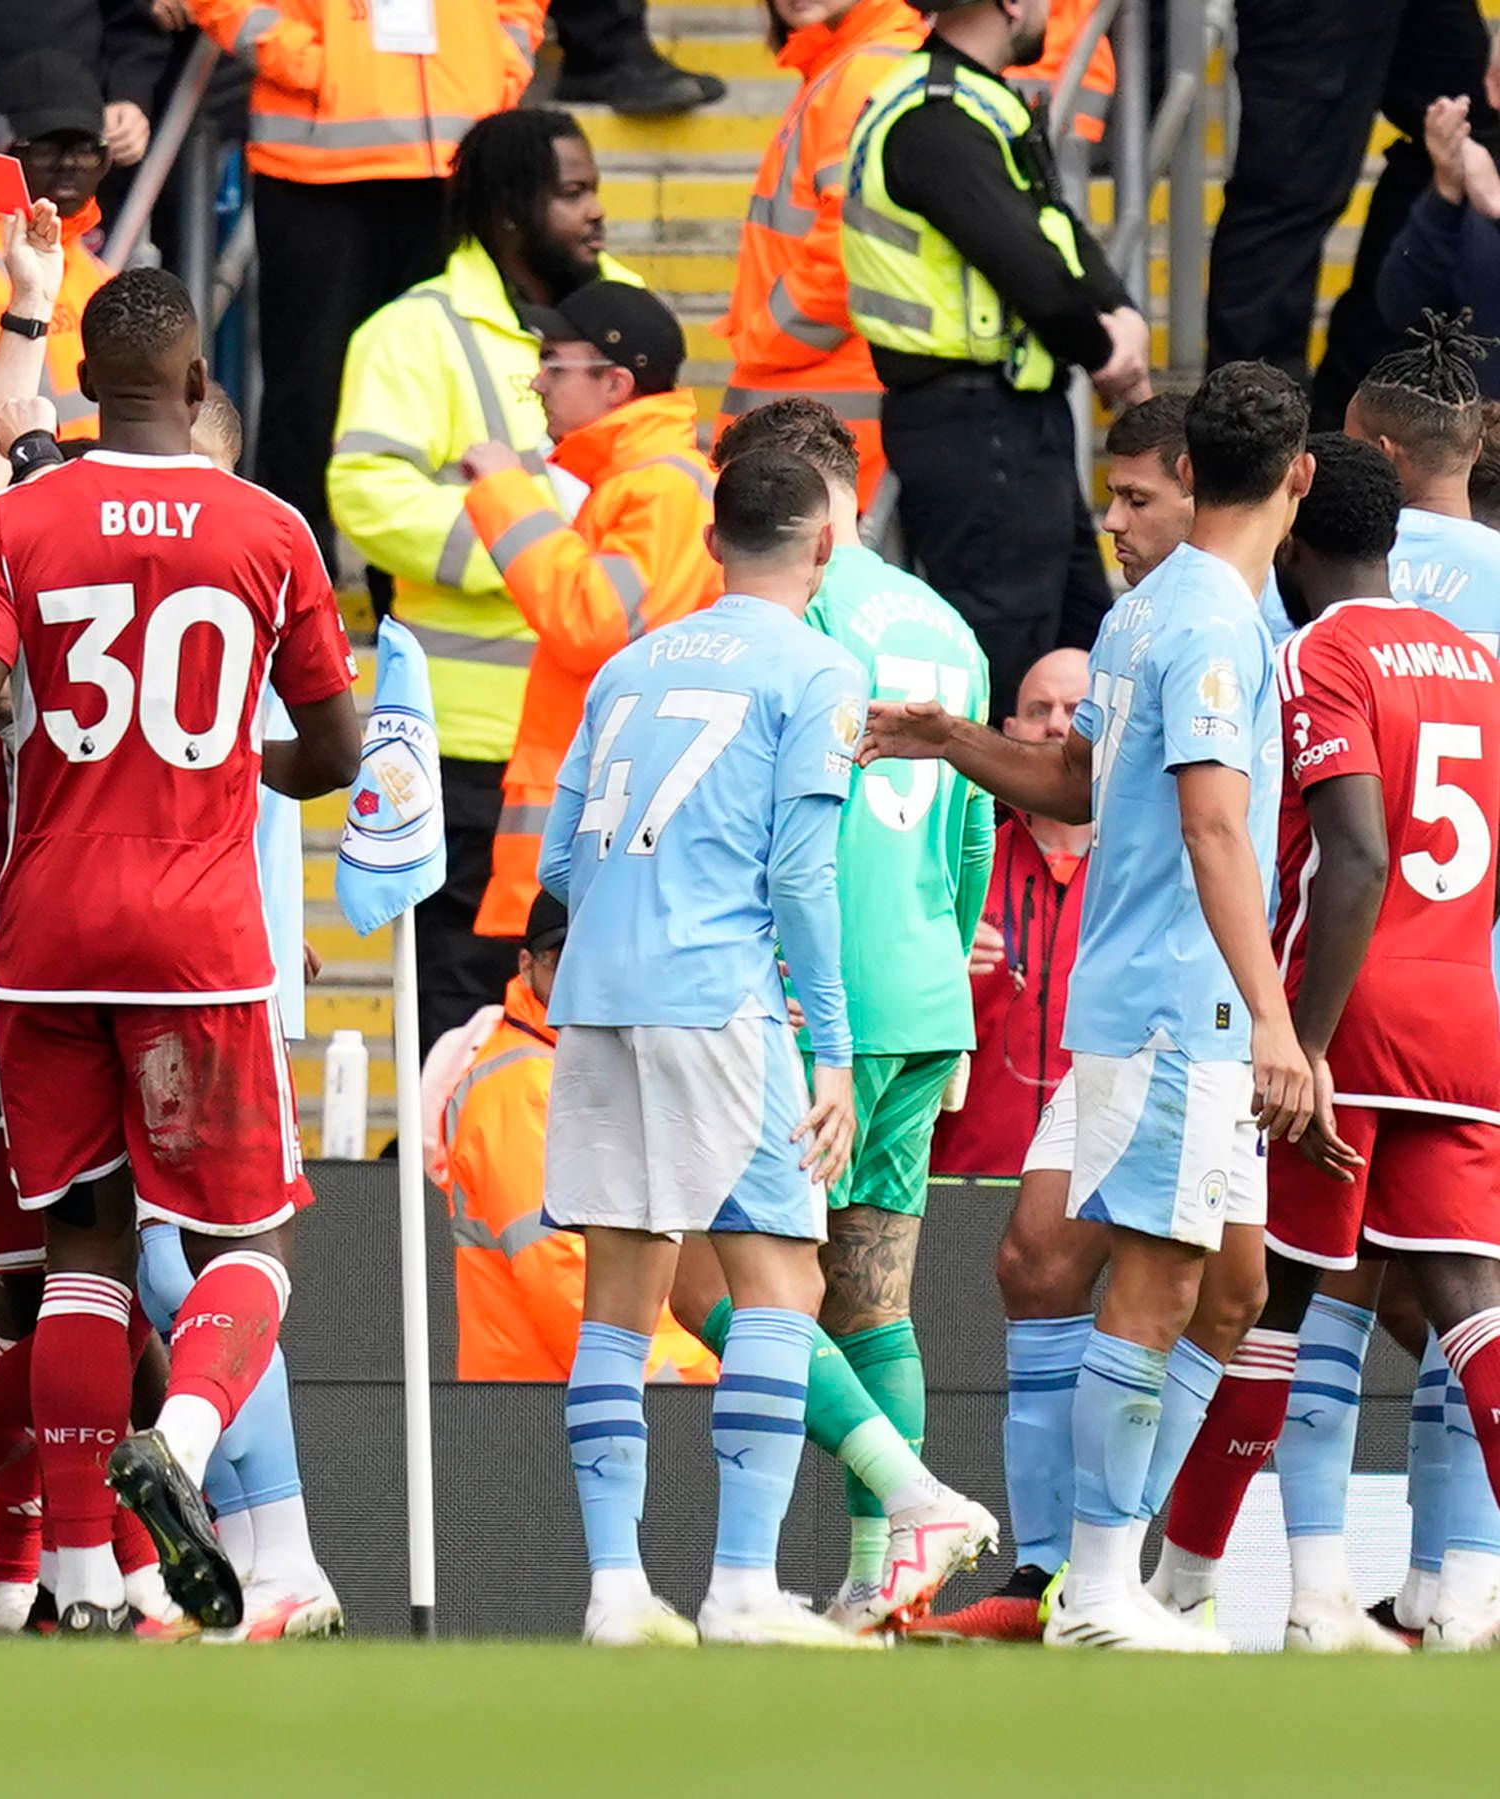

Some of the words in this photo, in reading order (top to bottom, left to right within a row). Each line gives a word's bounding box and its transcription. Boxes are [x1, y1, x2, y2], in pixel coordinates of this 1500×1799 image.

[101, 501, 201, 538] BOLY
[1392, 560, 1470, 603] ANJI
[650, 633, 749, 667] FODEN
[1368, 642, 1493, 683] MANGALA
[37, 583, 255, 769] 30
[577, 687, 752, 861] 47
[1401, 722, 1492, 902] 5
[170, 1312, 234, 1347] NFFC
[43, 1427, 117, 1445] NFFC
[1227, 1439, 1278, 1457] NFF
